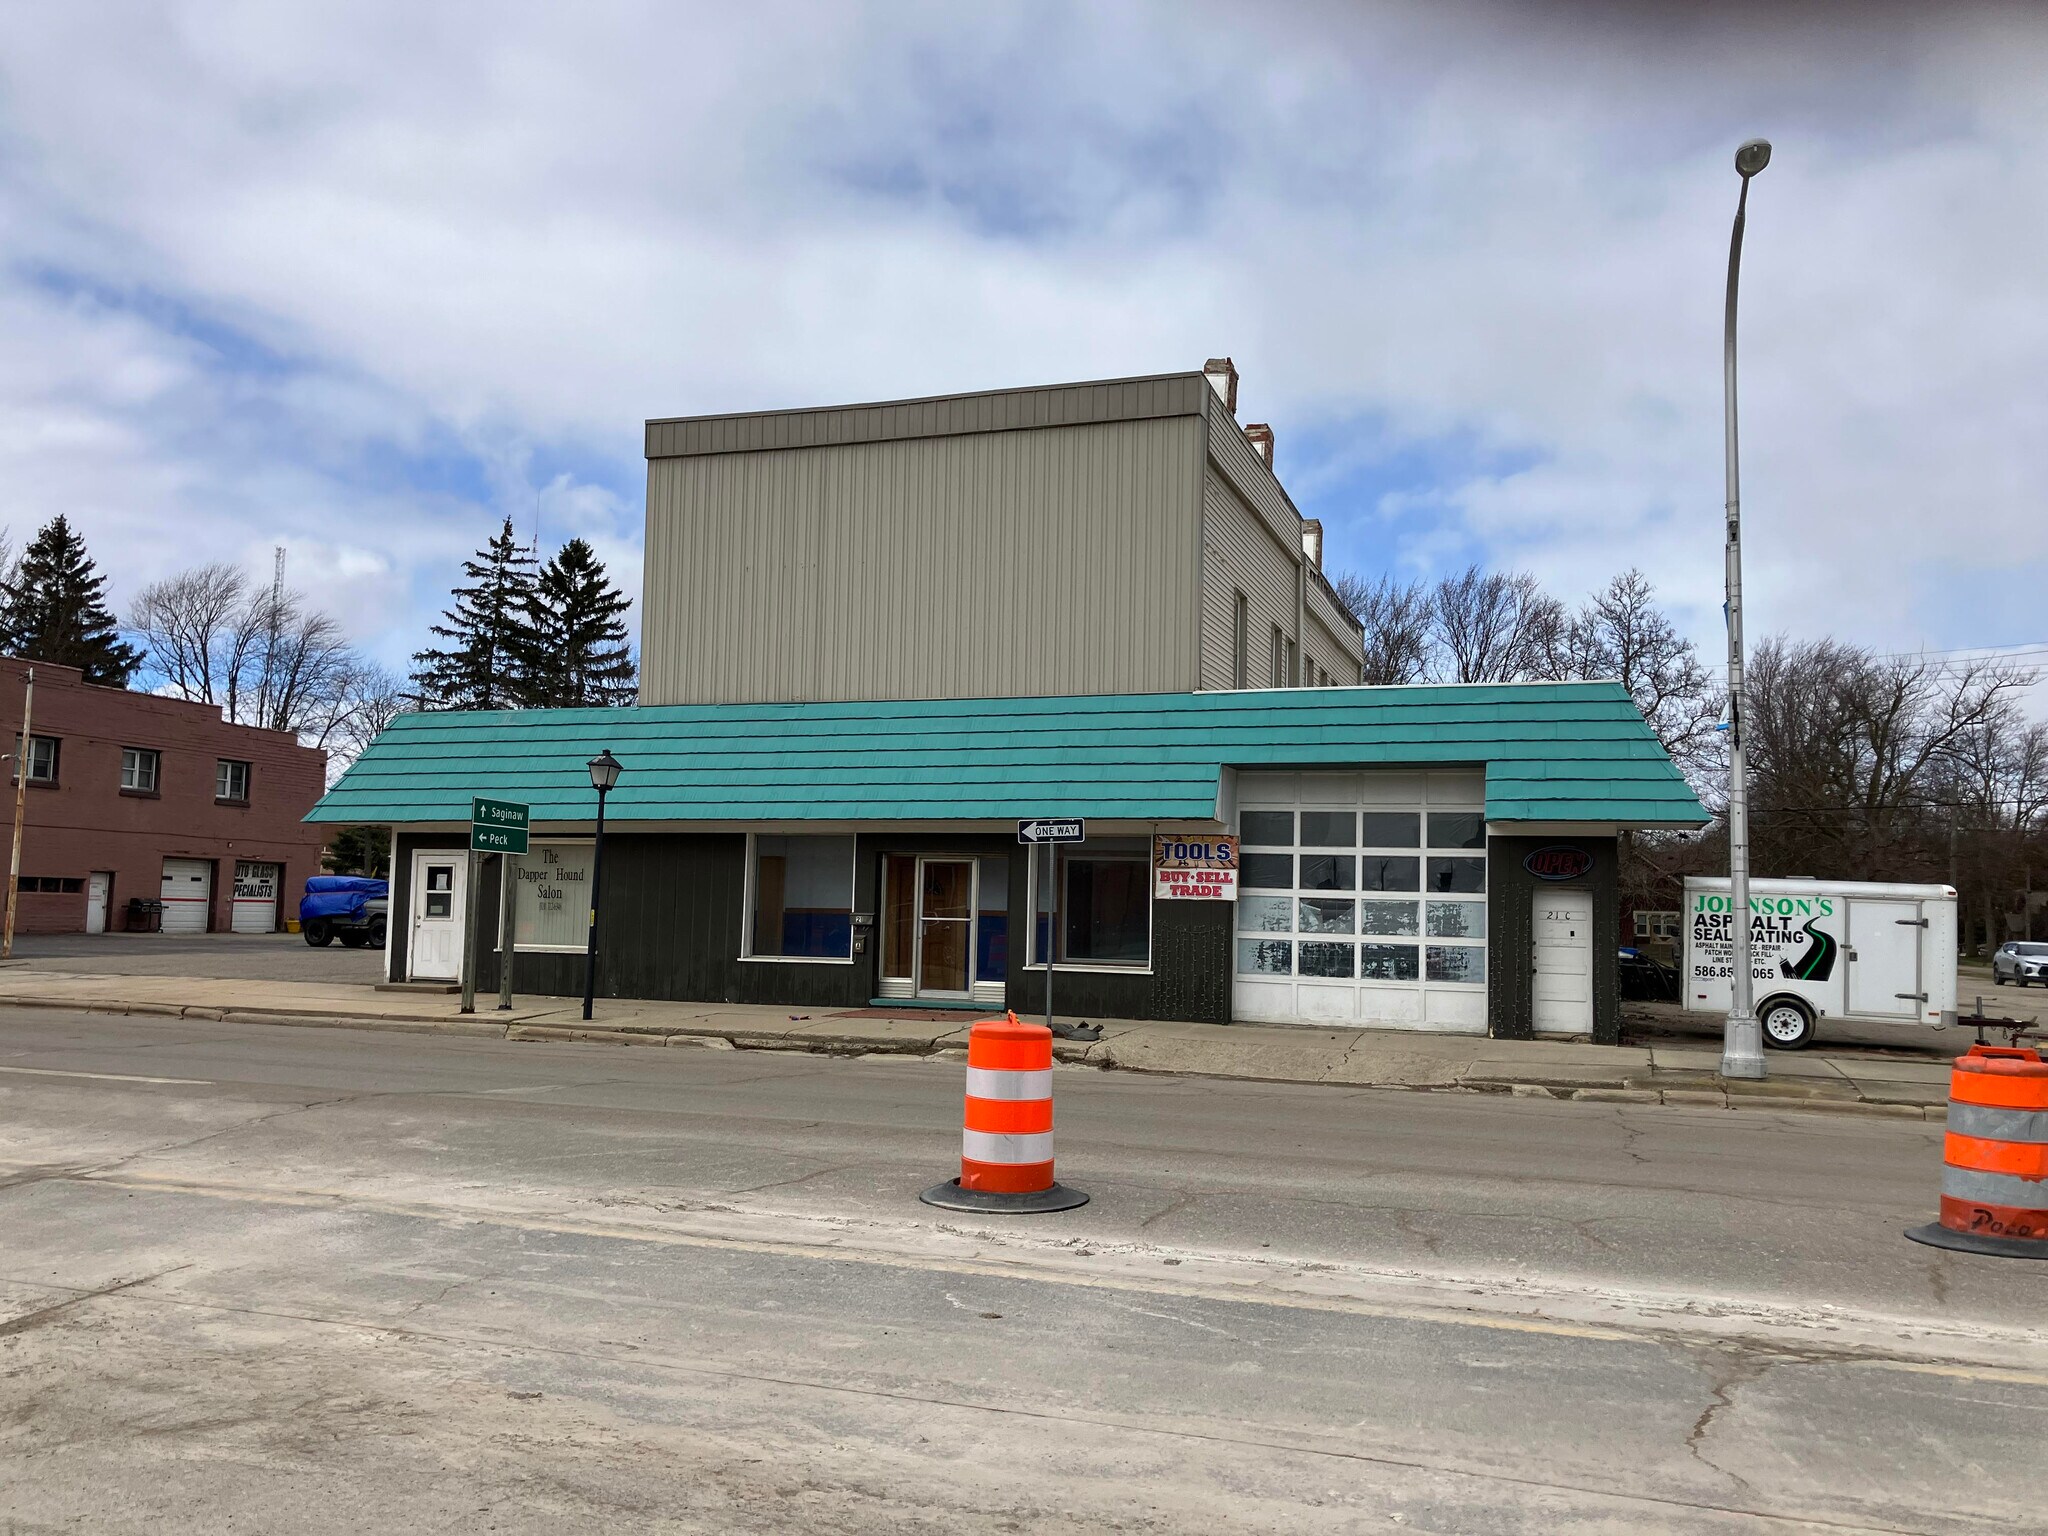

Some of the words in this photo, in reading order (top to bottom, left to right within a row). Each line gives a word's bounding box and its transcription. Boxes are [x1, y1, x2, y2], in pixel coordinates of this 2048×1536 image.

[491, 807, 524, 821] Saginaw
[1035, 826, 1055, 836] ONE
[1057, 825, 1077, 835] WAY
[489, 833, 508, 846] Peck
[542, 849, 559, 864] The
[1161, 842, 1232, 861] TOOLS
[235, 864, 250, 878] UTO
[251, 865, 274, 878] GLASS
[1532, 852, 1586, 875] OPEN
[517, 867, 548, 883] Dapper
[555, 867, 584, 881] Hound
[234, 884, 273, 898] PECIALISTS
[537, 884, 562, 899] Salon
[1170, 884, 1222, 897] TRADE
[1694, 914, 1792, 930] ASPALT
[1693, 928, 1804, 944] SEALATING
